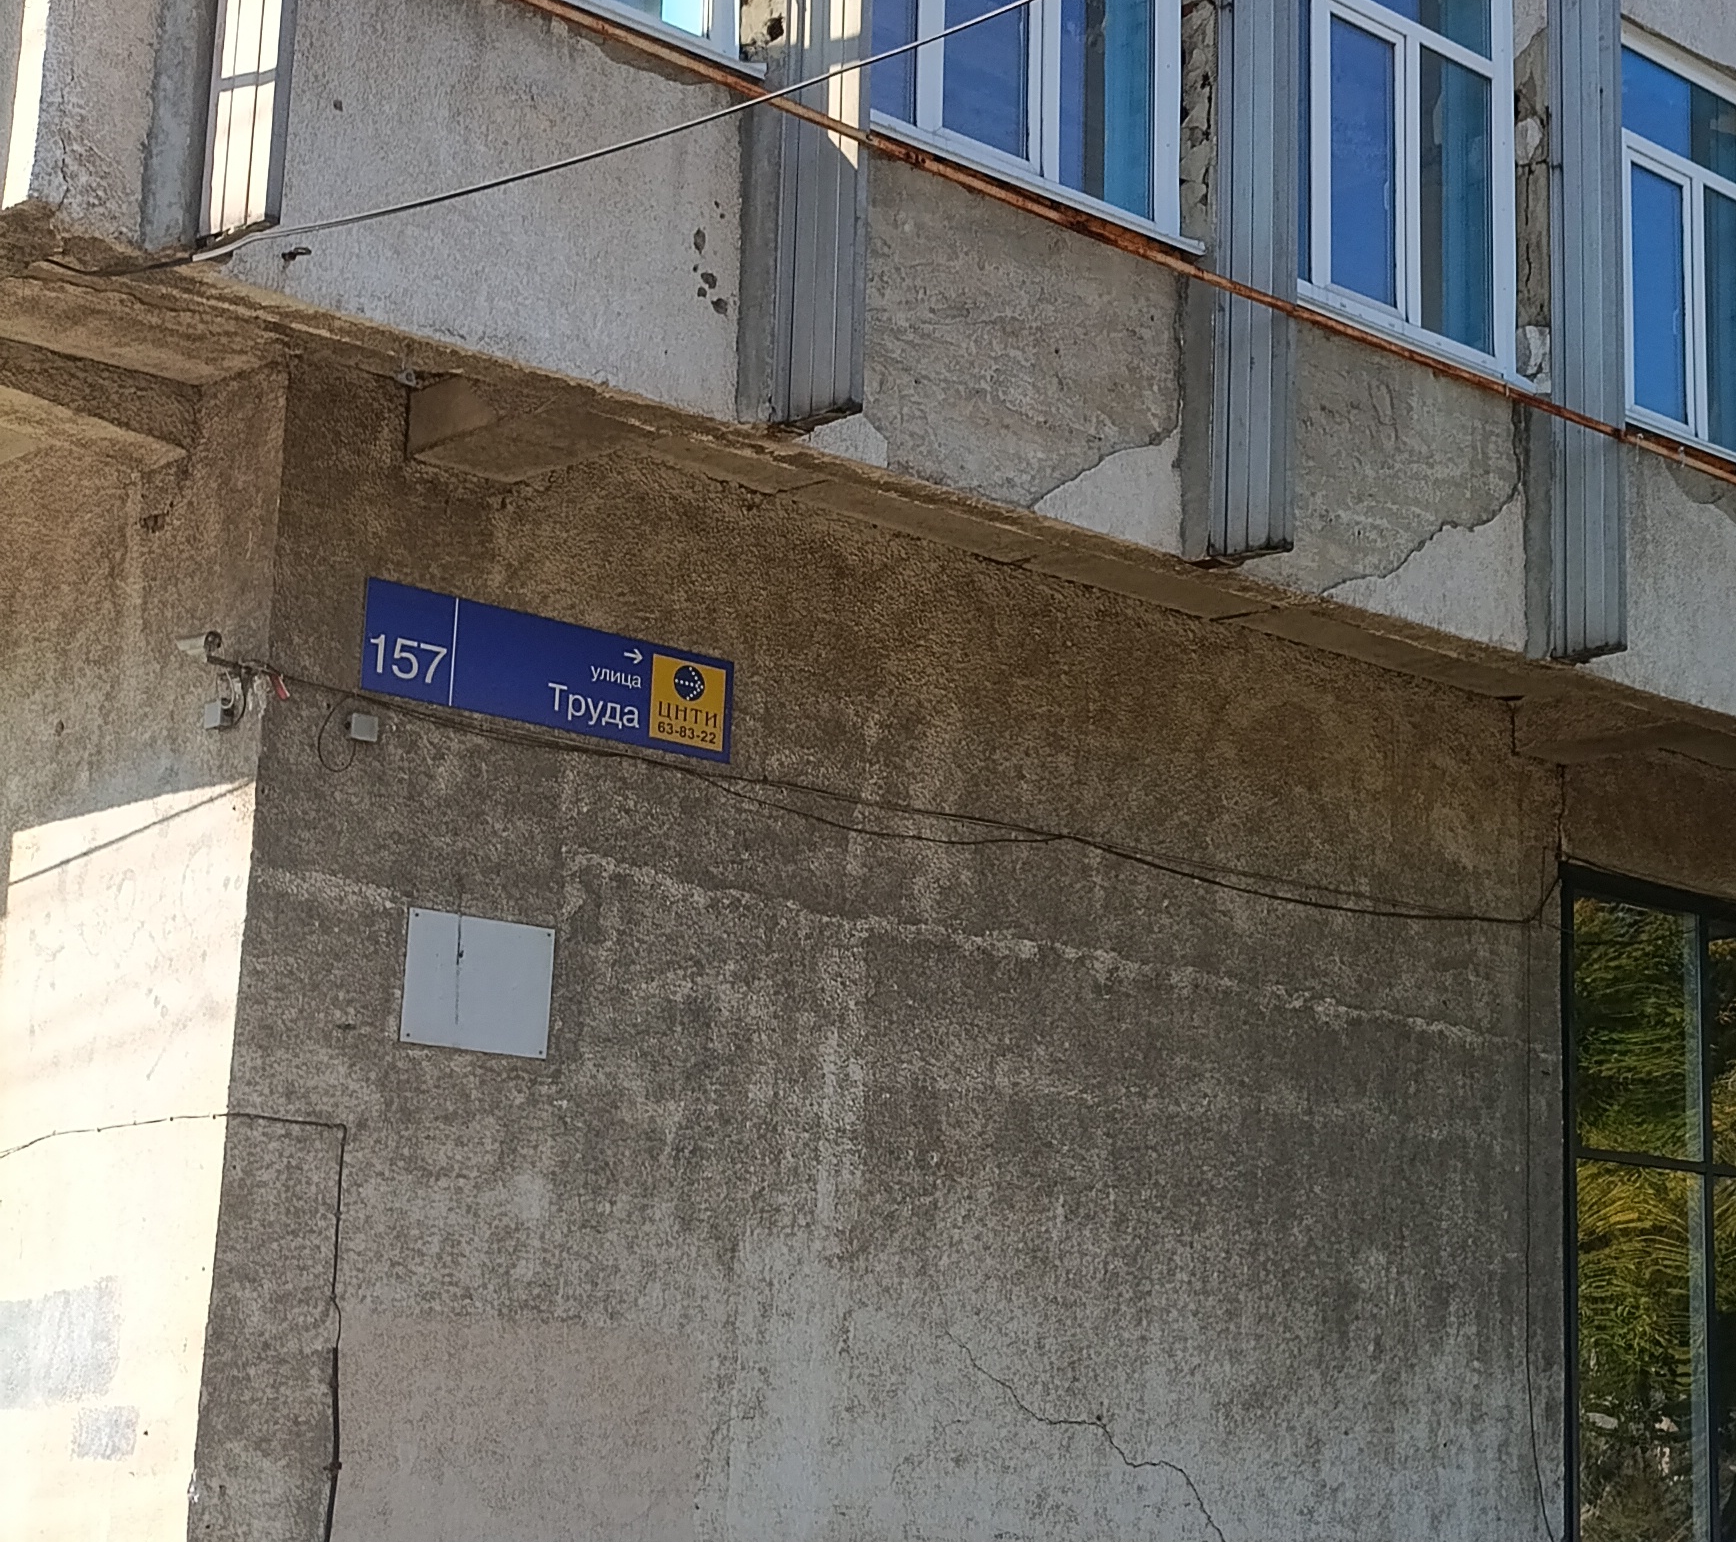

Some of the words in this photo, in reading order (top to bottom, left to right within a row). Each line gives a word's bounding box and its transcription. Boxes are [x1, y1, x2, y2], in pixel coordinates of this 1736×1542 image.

[369, 633, 448, 685] 157
[590, 665, 642, 689] улица
[547, 682, 641, 730] Труда
[656, 700, 720, 730] ЦНТИ
[656, 721, 718, 746] 63-83-22
